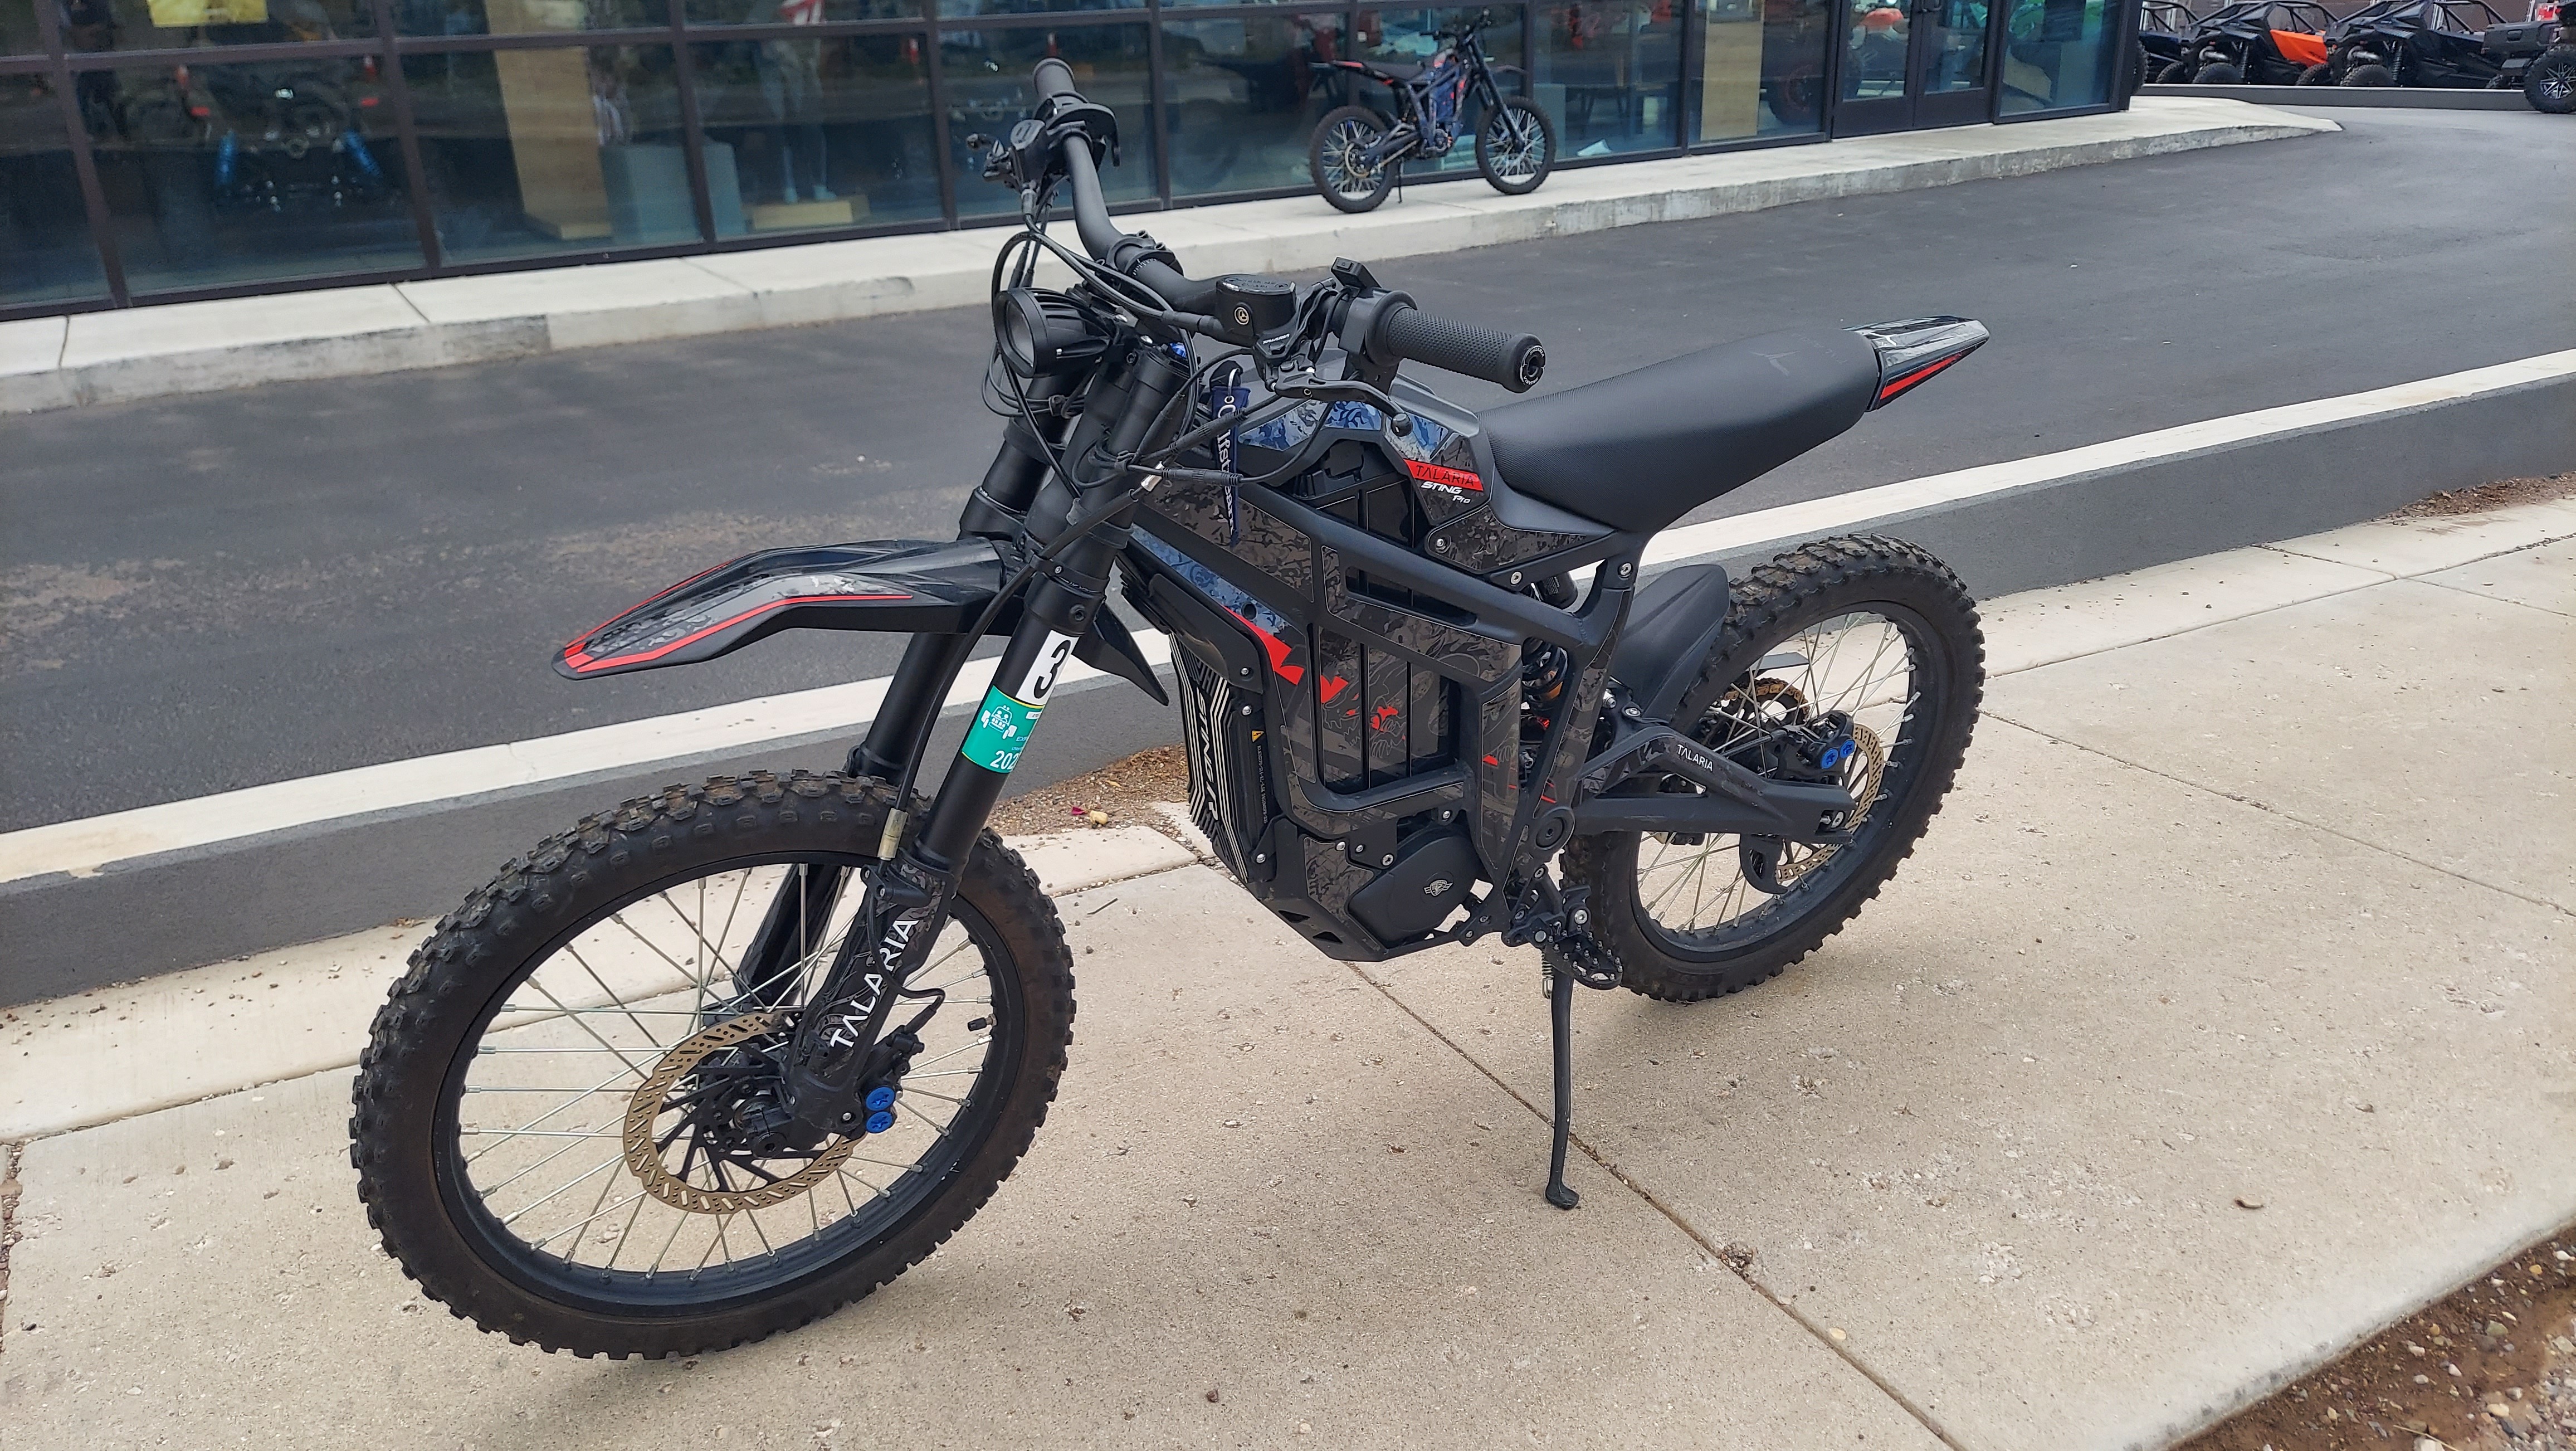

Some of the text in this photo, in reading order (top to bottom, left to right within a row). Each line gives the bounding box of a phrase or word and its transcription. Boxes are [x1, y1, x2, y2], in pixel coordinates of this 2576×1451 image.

[1416, 465, 1474, 486] TALARIA
[1421, 481, 1463, 494] STING
[1452, 495, 1471, 504] Pro
[1033, 640, 1071, 699] 3
[1677, 744, 1713, 772] TALARIA
[830, 919, 919, 1048] TALARIA
